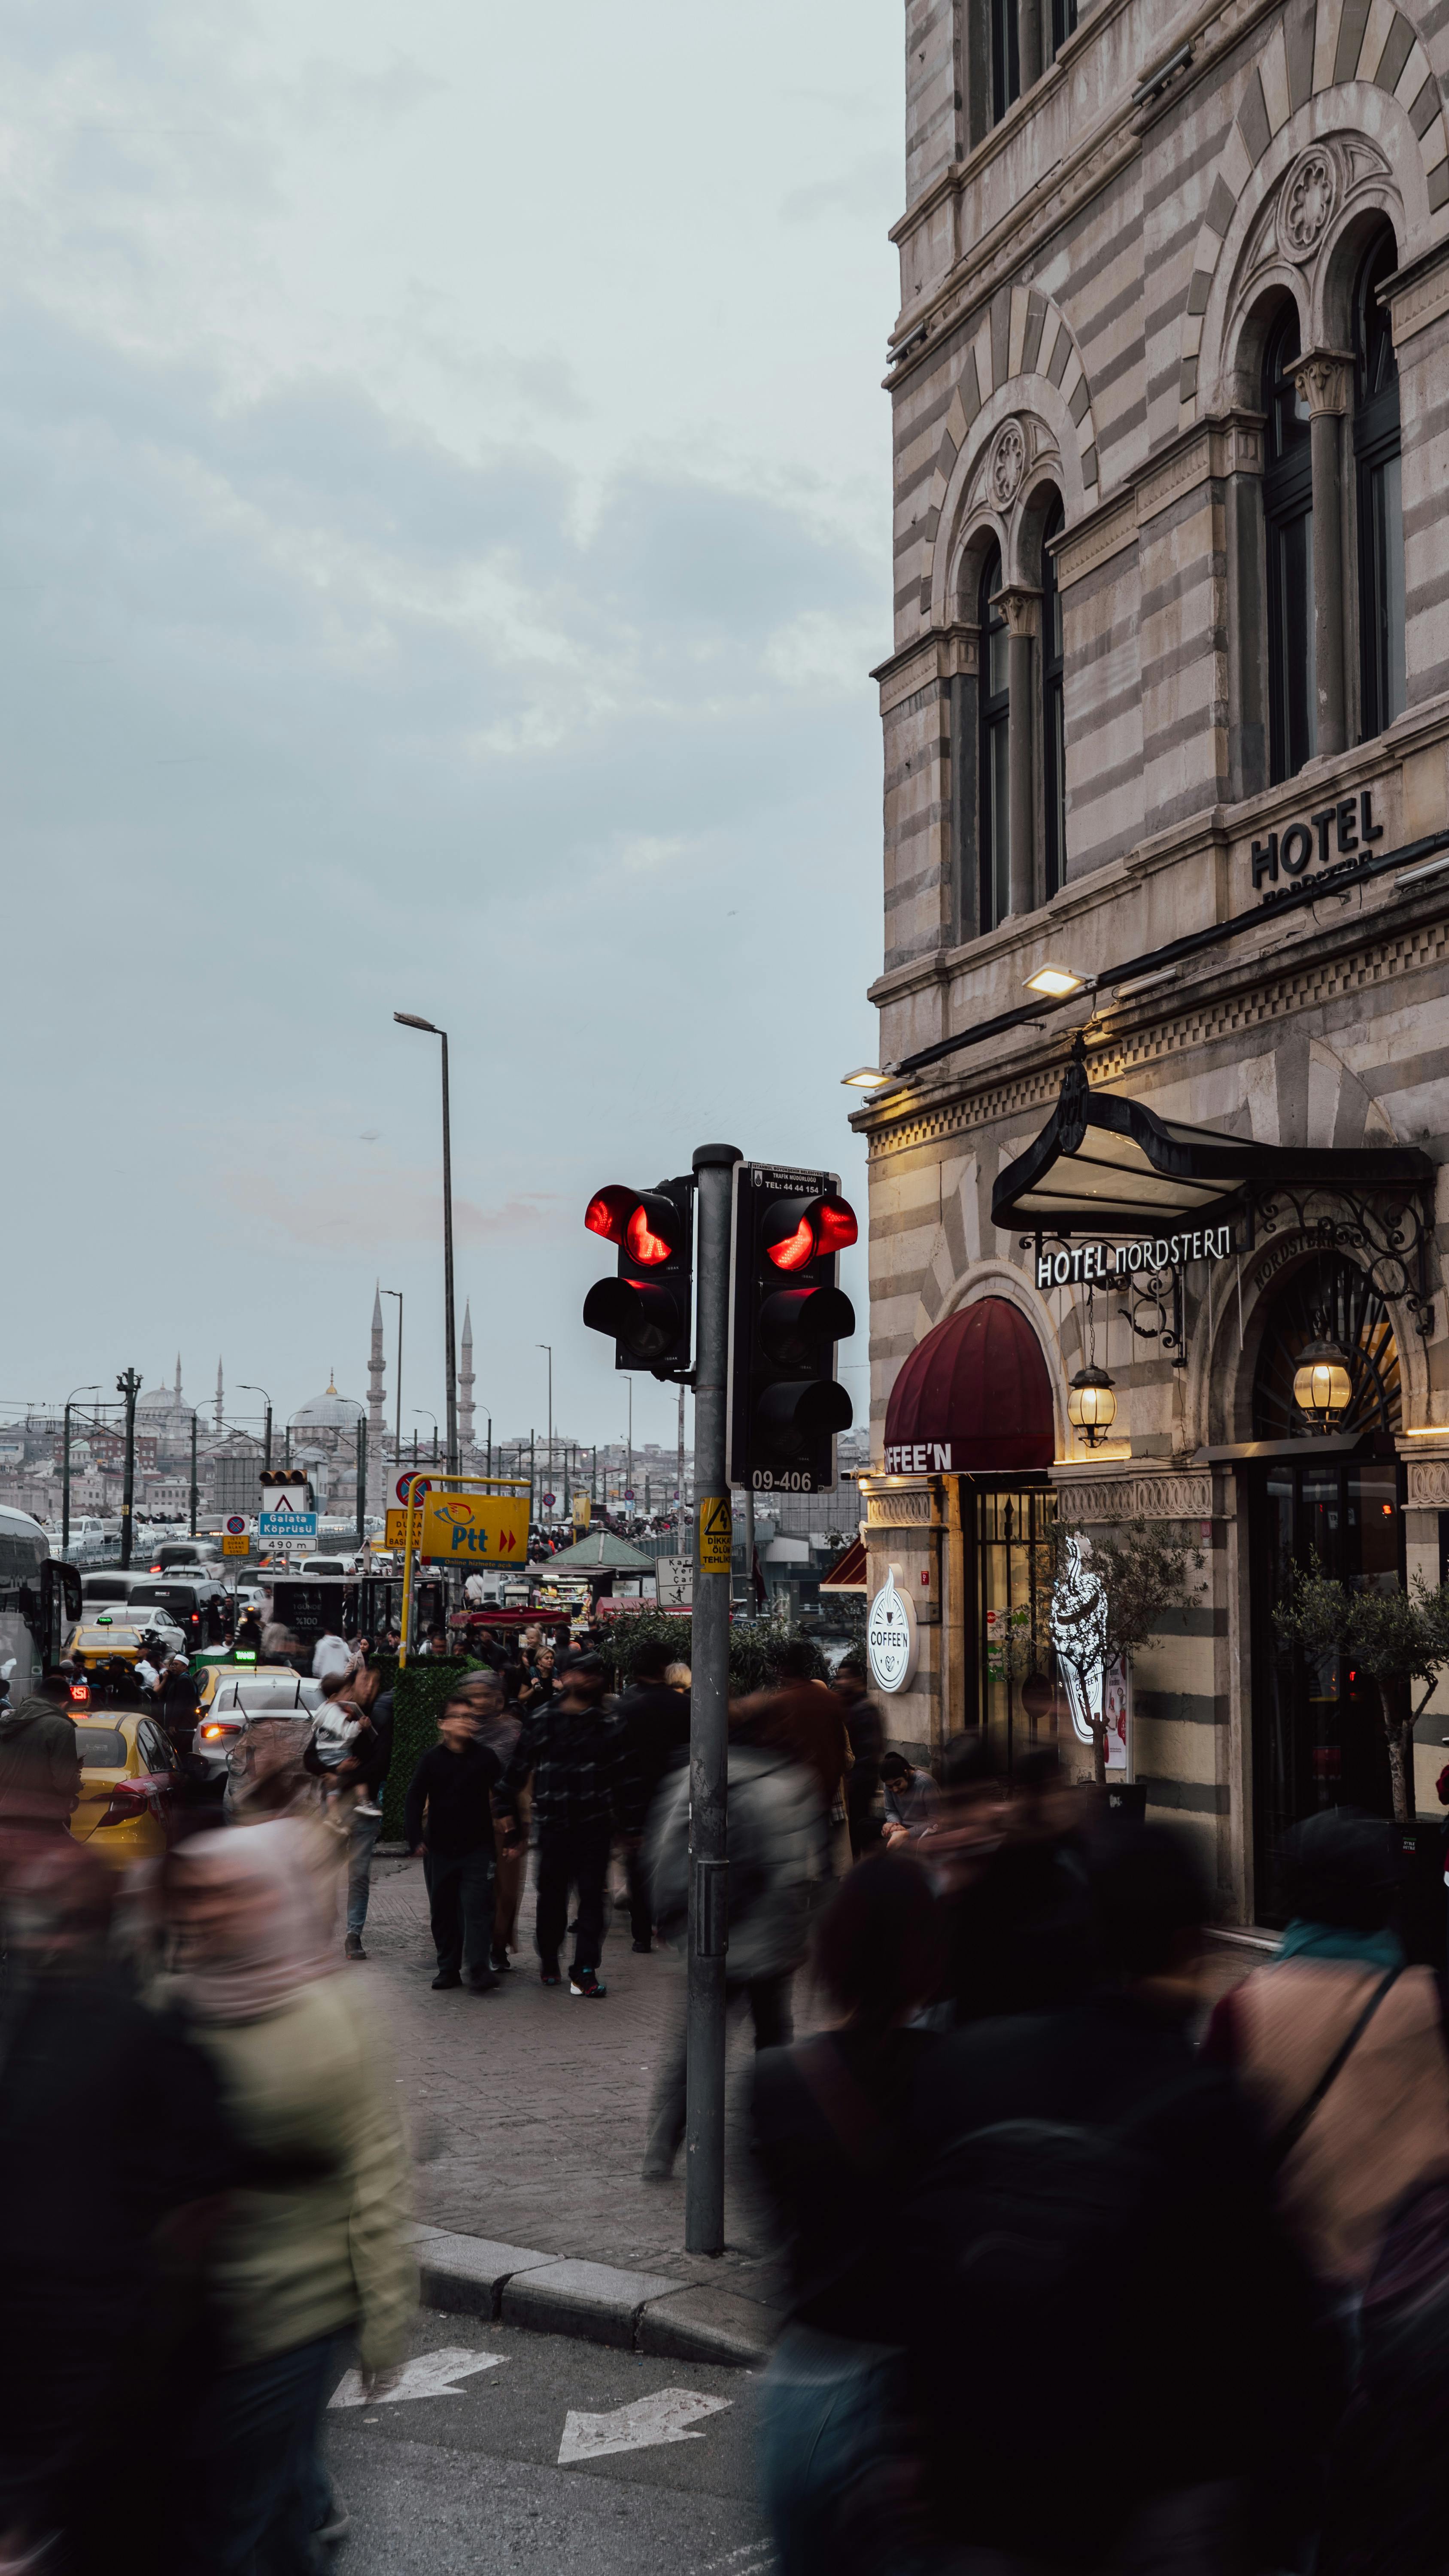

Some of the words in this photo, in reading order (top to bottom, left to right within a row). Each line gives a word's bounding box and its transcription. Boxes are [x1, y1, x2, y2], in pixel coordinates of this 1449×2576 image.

[1251, 791, 1383, 888] HOTEL
[790, 1174, 816, 1183] MÜDÜRLÜĞÜ
[1038, 1245, 1106, 1288] HOTEL
[884, 1443, 951, 1473] OFFEE'N
[753, 1470, 811, 1491] 09-406
[270, 1514, 307, 1522] Galata
[264, 1525, 312, 1534] Köprüsü
[452, 1525, 488, 1552] Ptt
[871, 1631, 907, 1647] COFFEE'N
